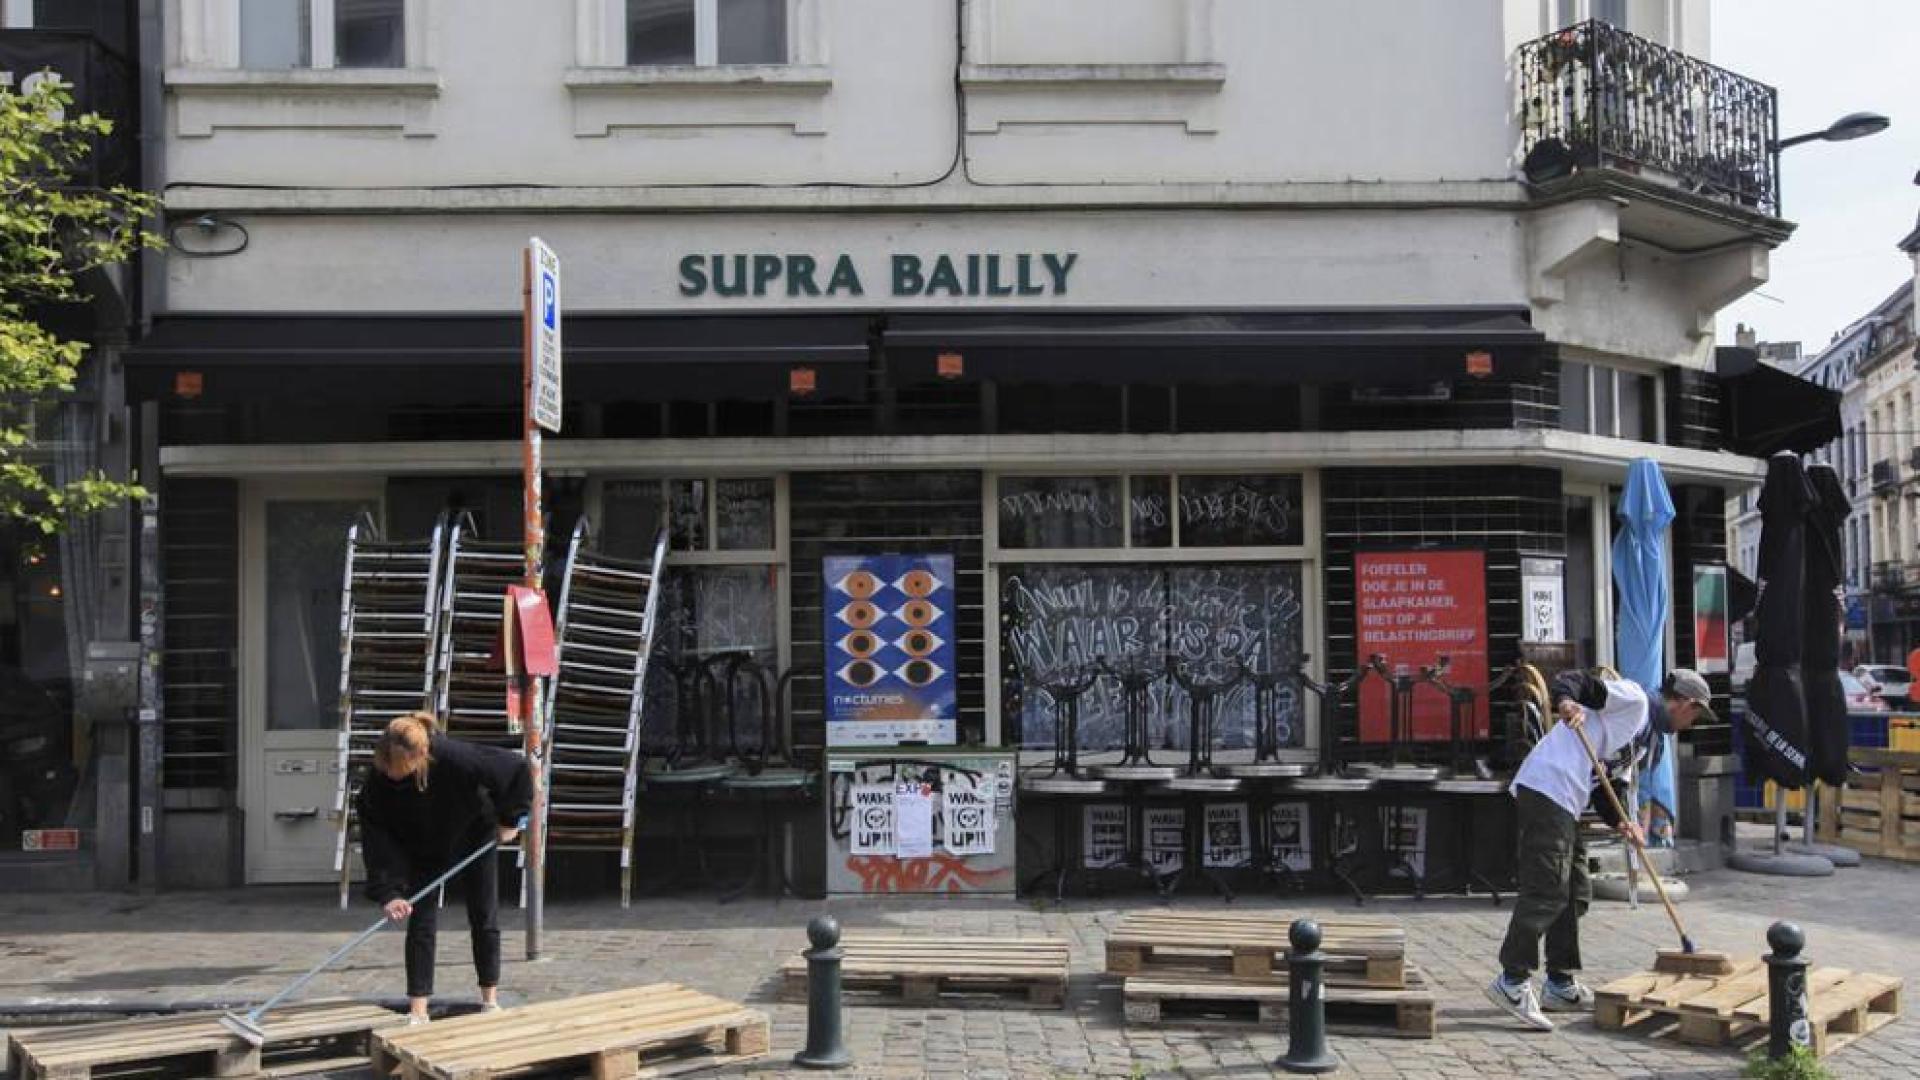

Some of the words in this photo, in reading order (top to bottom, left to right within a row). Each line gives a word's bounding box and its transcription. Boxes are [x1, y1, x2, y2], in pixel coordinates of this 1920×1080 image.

[679, 253, 863, 296] SUPRA
[891, 253, 1078, 296] BAILLY
[1362, 579, 1390, 592] DOE
[1393, 579, 1408, 592] JE
[1410, 579, 1425, 592] IN
[1428, 579, 1445, 592] DE
[1363, 613, 1393, 626] NIET
[1396, 613, 1416, 626] OP
[1419, 613, 1435, 626] JE
[856, 791, 893, 805] WAKE
[949, 791, 986, 805] WAK
